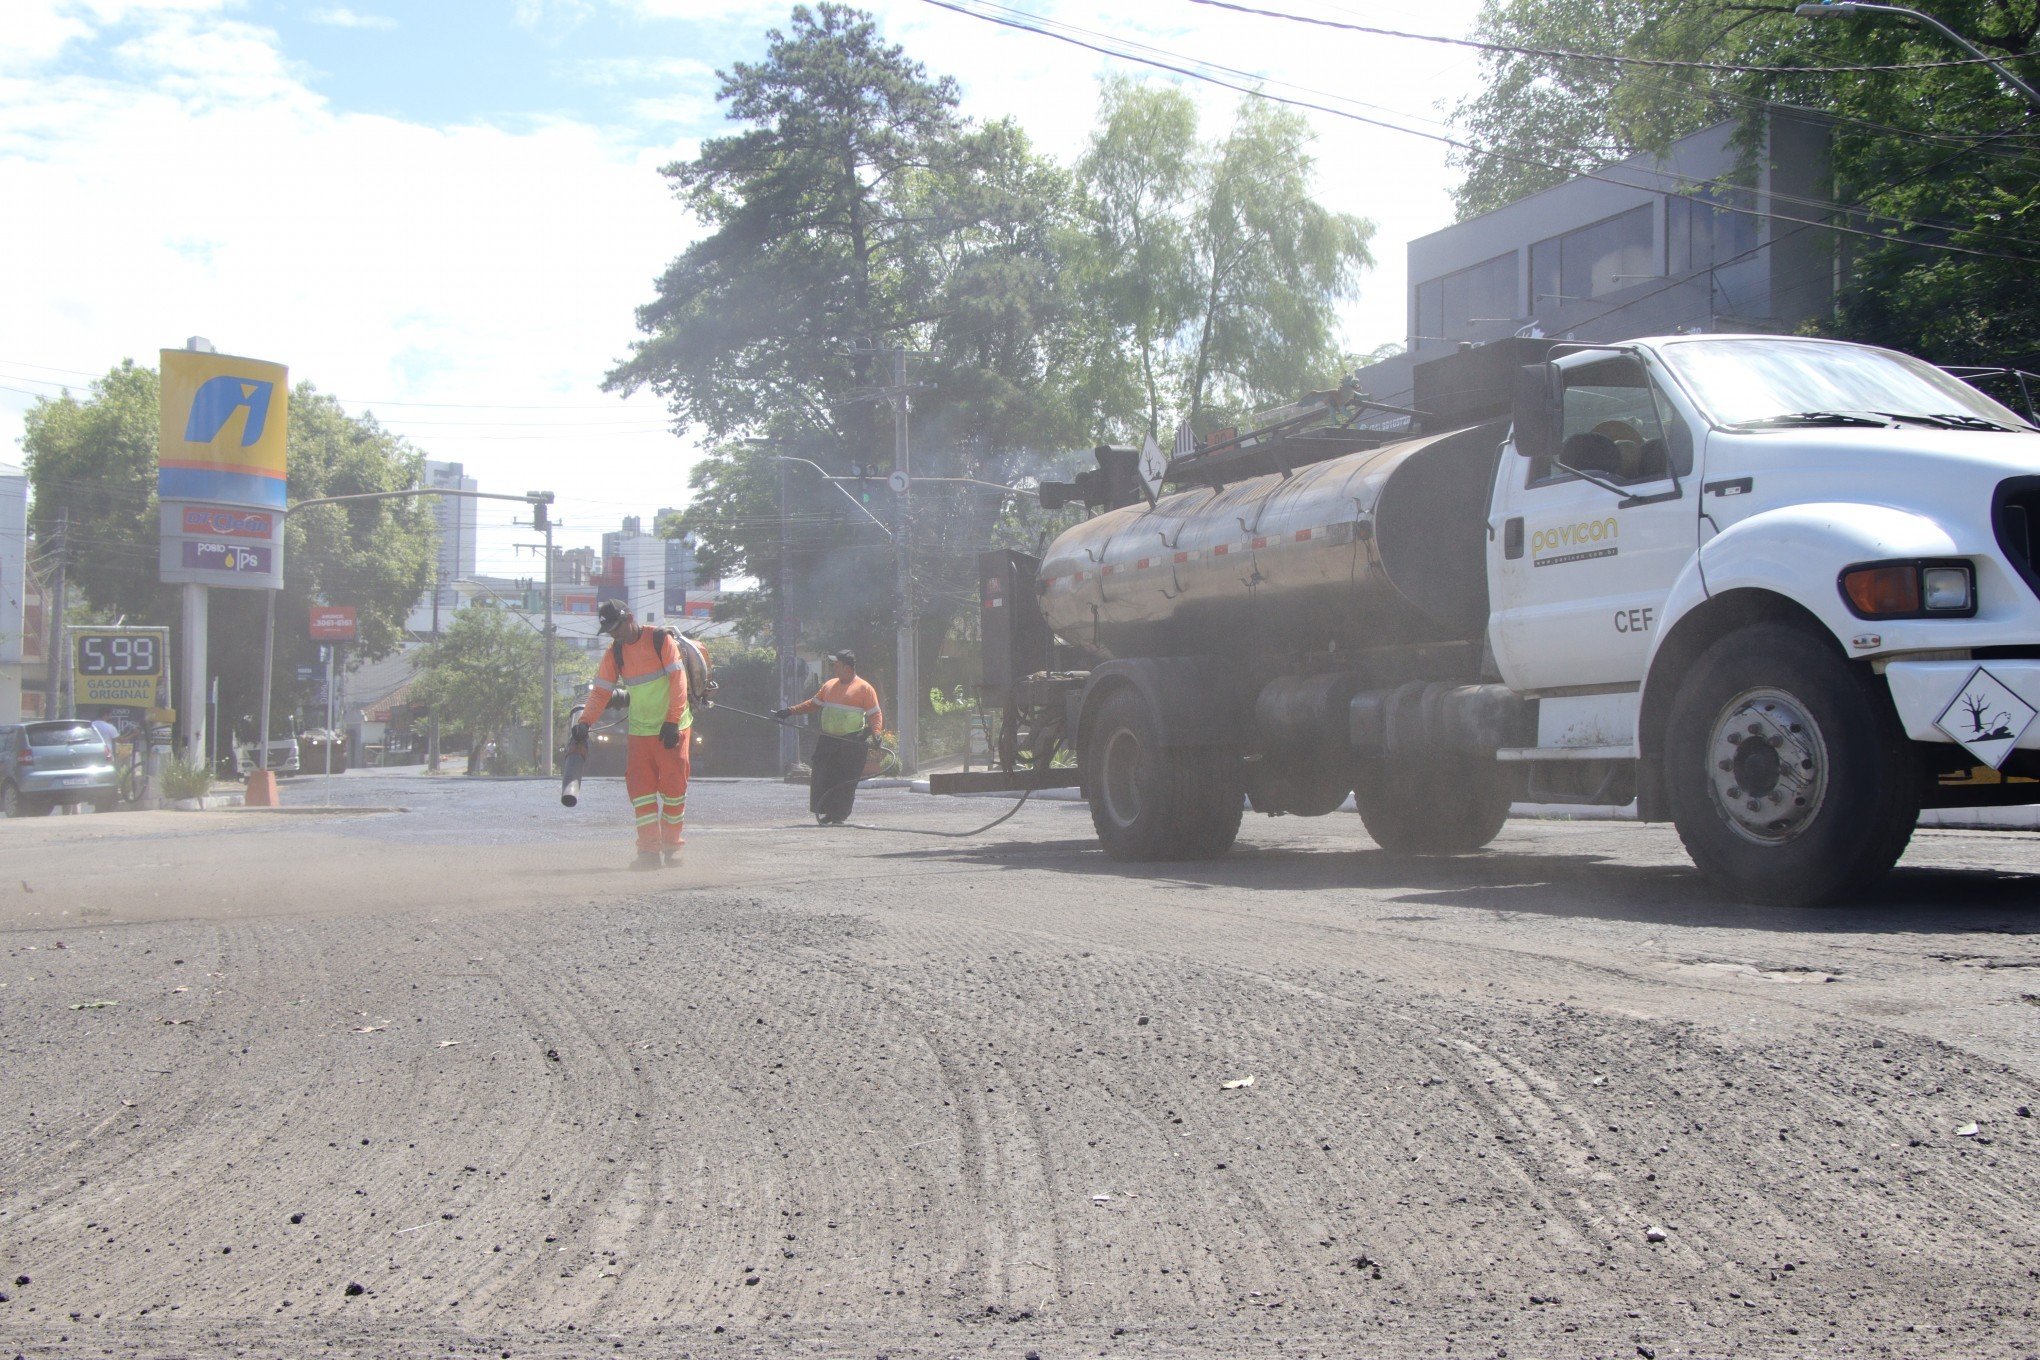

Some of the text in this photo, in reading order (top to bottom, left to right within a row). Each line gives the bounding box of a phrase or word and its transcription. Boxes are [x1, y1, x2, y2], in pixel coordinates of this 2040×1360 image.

[1532, 517, 1618, 559] pavicon
[85, 638, 153, 674] 5,99
[87, 679, 151, 689] GASOLINA
[89, 690, 150, 699] ORIGINAL
